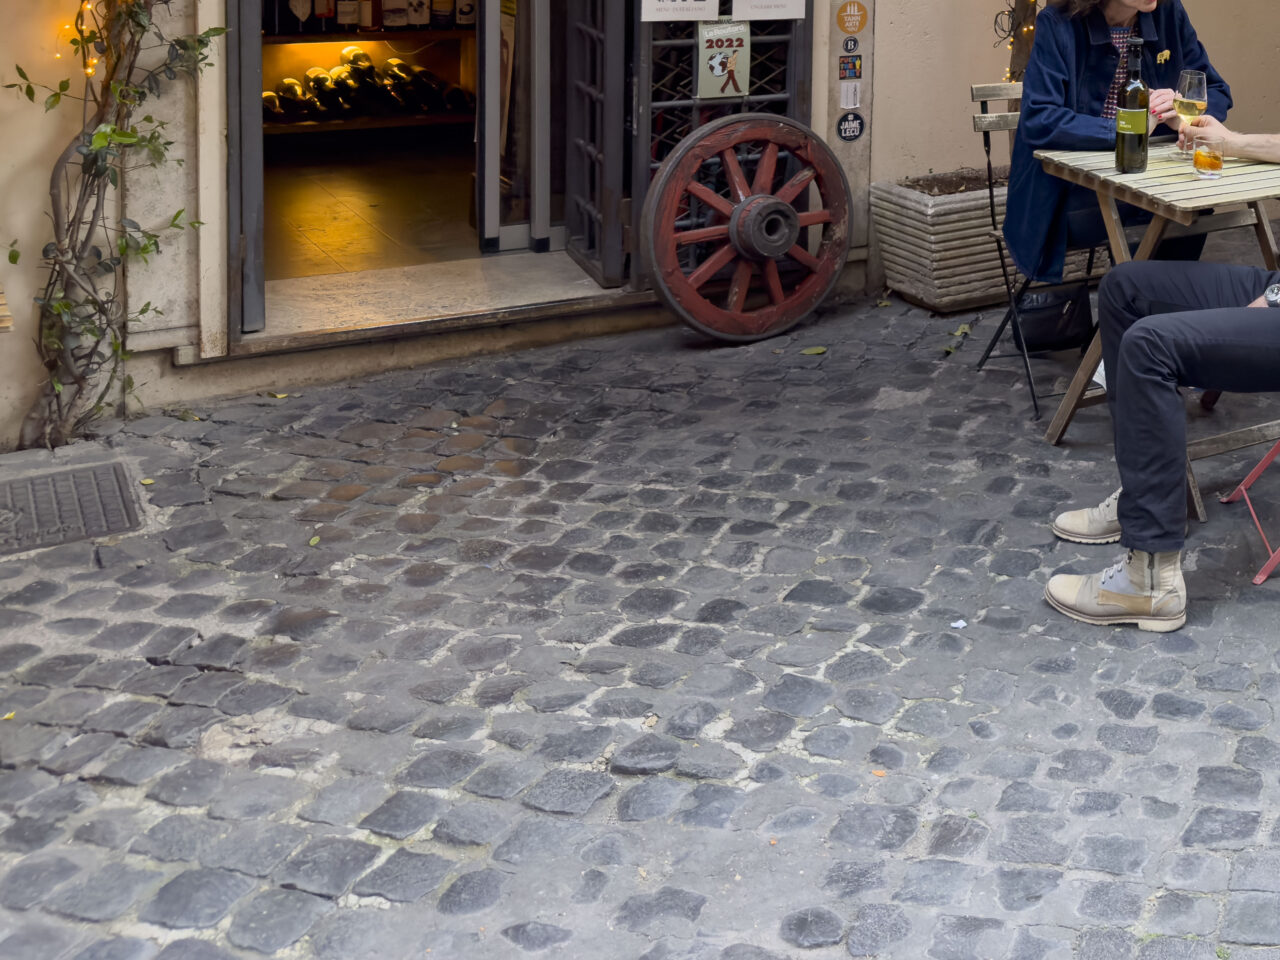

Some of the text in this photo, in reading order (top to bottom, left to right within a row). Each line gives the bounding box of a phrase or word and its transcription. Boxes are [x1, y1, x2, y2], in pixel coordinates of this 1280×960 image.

[705, 37, 744, 49] 2022
[847, 41, 855, 50] B
[840, 121, 860, 129] JAIME
